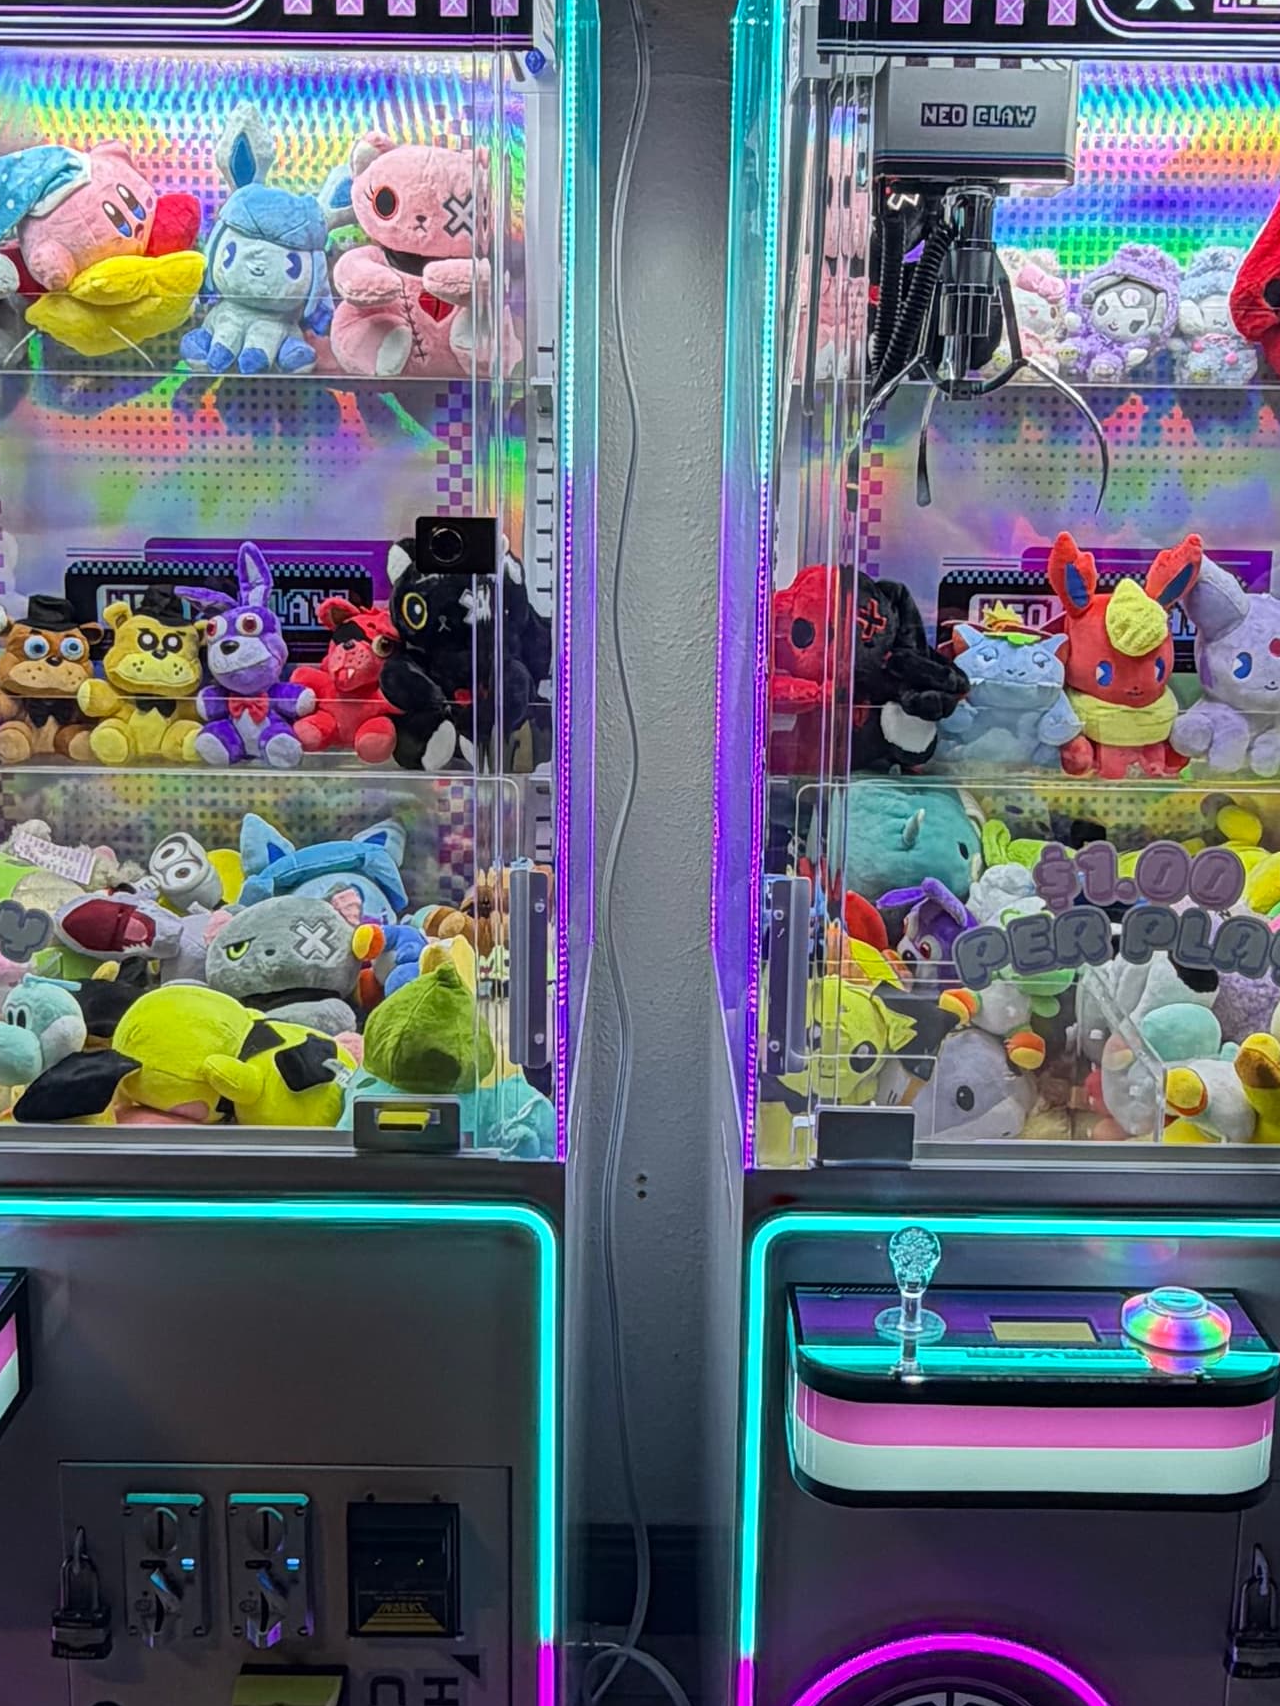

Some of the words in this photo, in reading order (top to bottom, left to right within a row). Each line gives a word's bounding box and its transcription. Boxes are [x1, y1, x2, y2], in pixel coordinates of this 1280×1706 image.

[922, 103, 967, 127] NEO
[973, 105, 1036, 127] CLAW
[1033, 840, 1245, 913] $1.00
[953, 905, 1113, 991] PER
